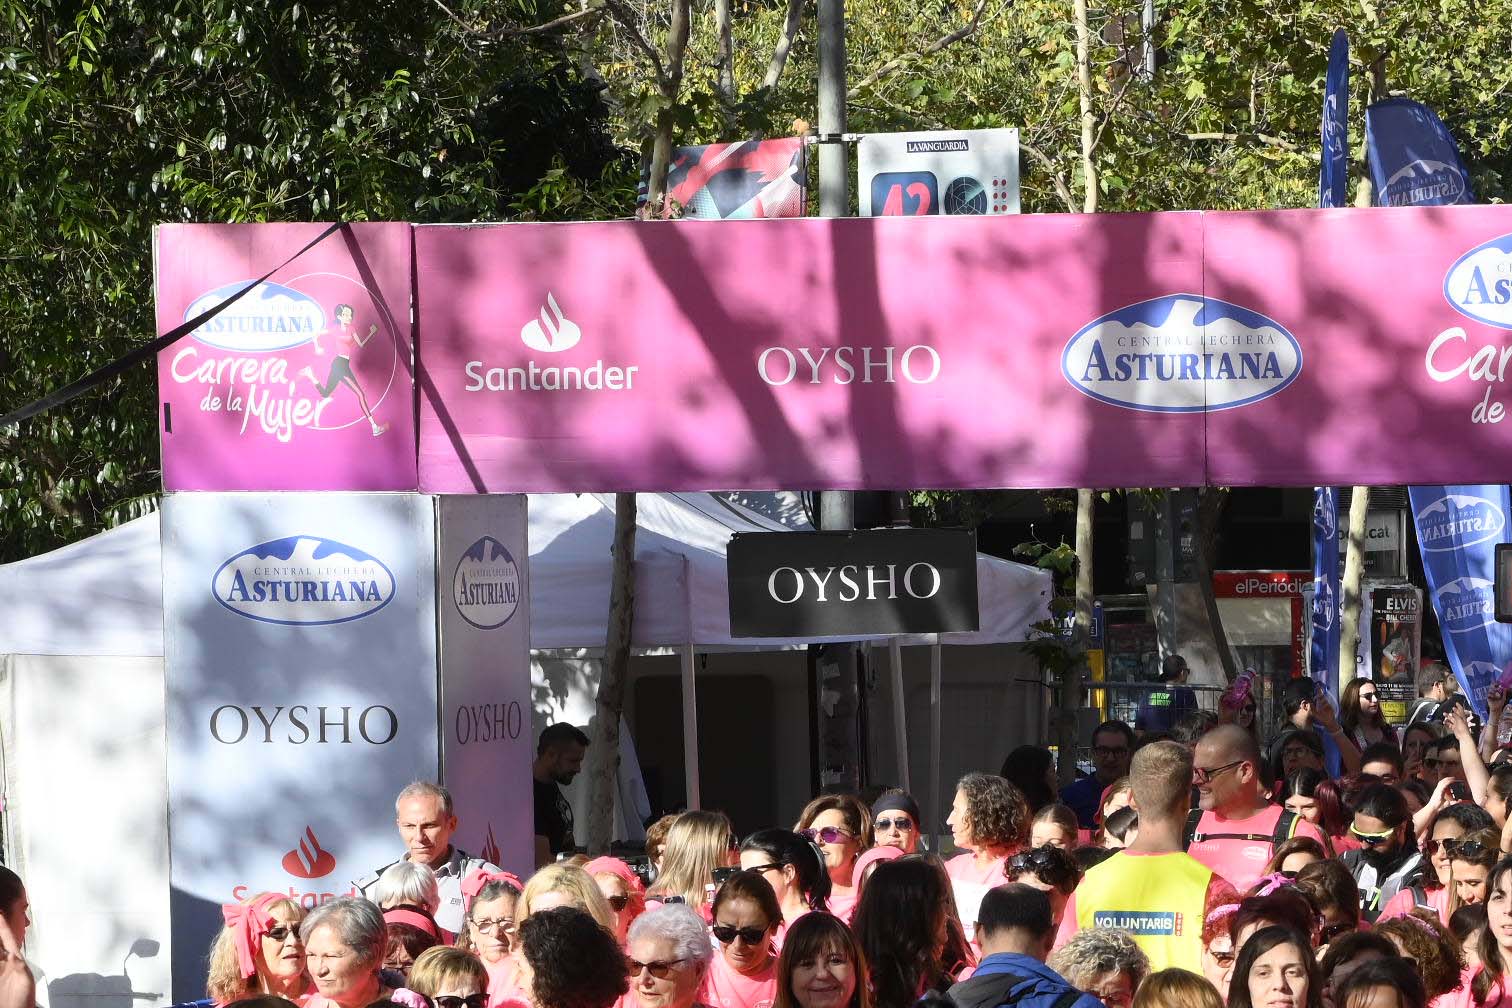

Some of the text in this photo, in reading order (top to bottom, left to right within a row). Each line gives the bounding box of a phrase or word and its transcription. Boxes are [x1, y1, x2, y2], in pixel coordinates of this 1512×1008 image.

[1117, 333, 1277, 348] CENTRAL LECHERA
[171, 347, 289, 384] Carrera
[465, 360, 639, 392] Santander
[757, 344, 941, 386] OYSHO
[1081, 339, 1284, 382] ASTURIANA
[200, 381, 334, 442] de la Mujer
[1471, 386, 1505, 424] de
[226, 568, 383, 602] ASTURIANA
[459, 570, 517, 606] ASTURIANA
[767, 562, 942, 604] OYSHO
[209, 704, 399, 745] OYSHO
[455, 701, 522, 745] OYSHO
[1095, 911, 1173, 932] VOLUNTARIS
